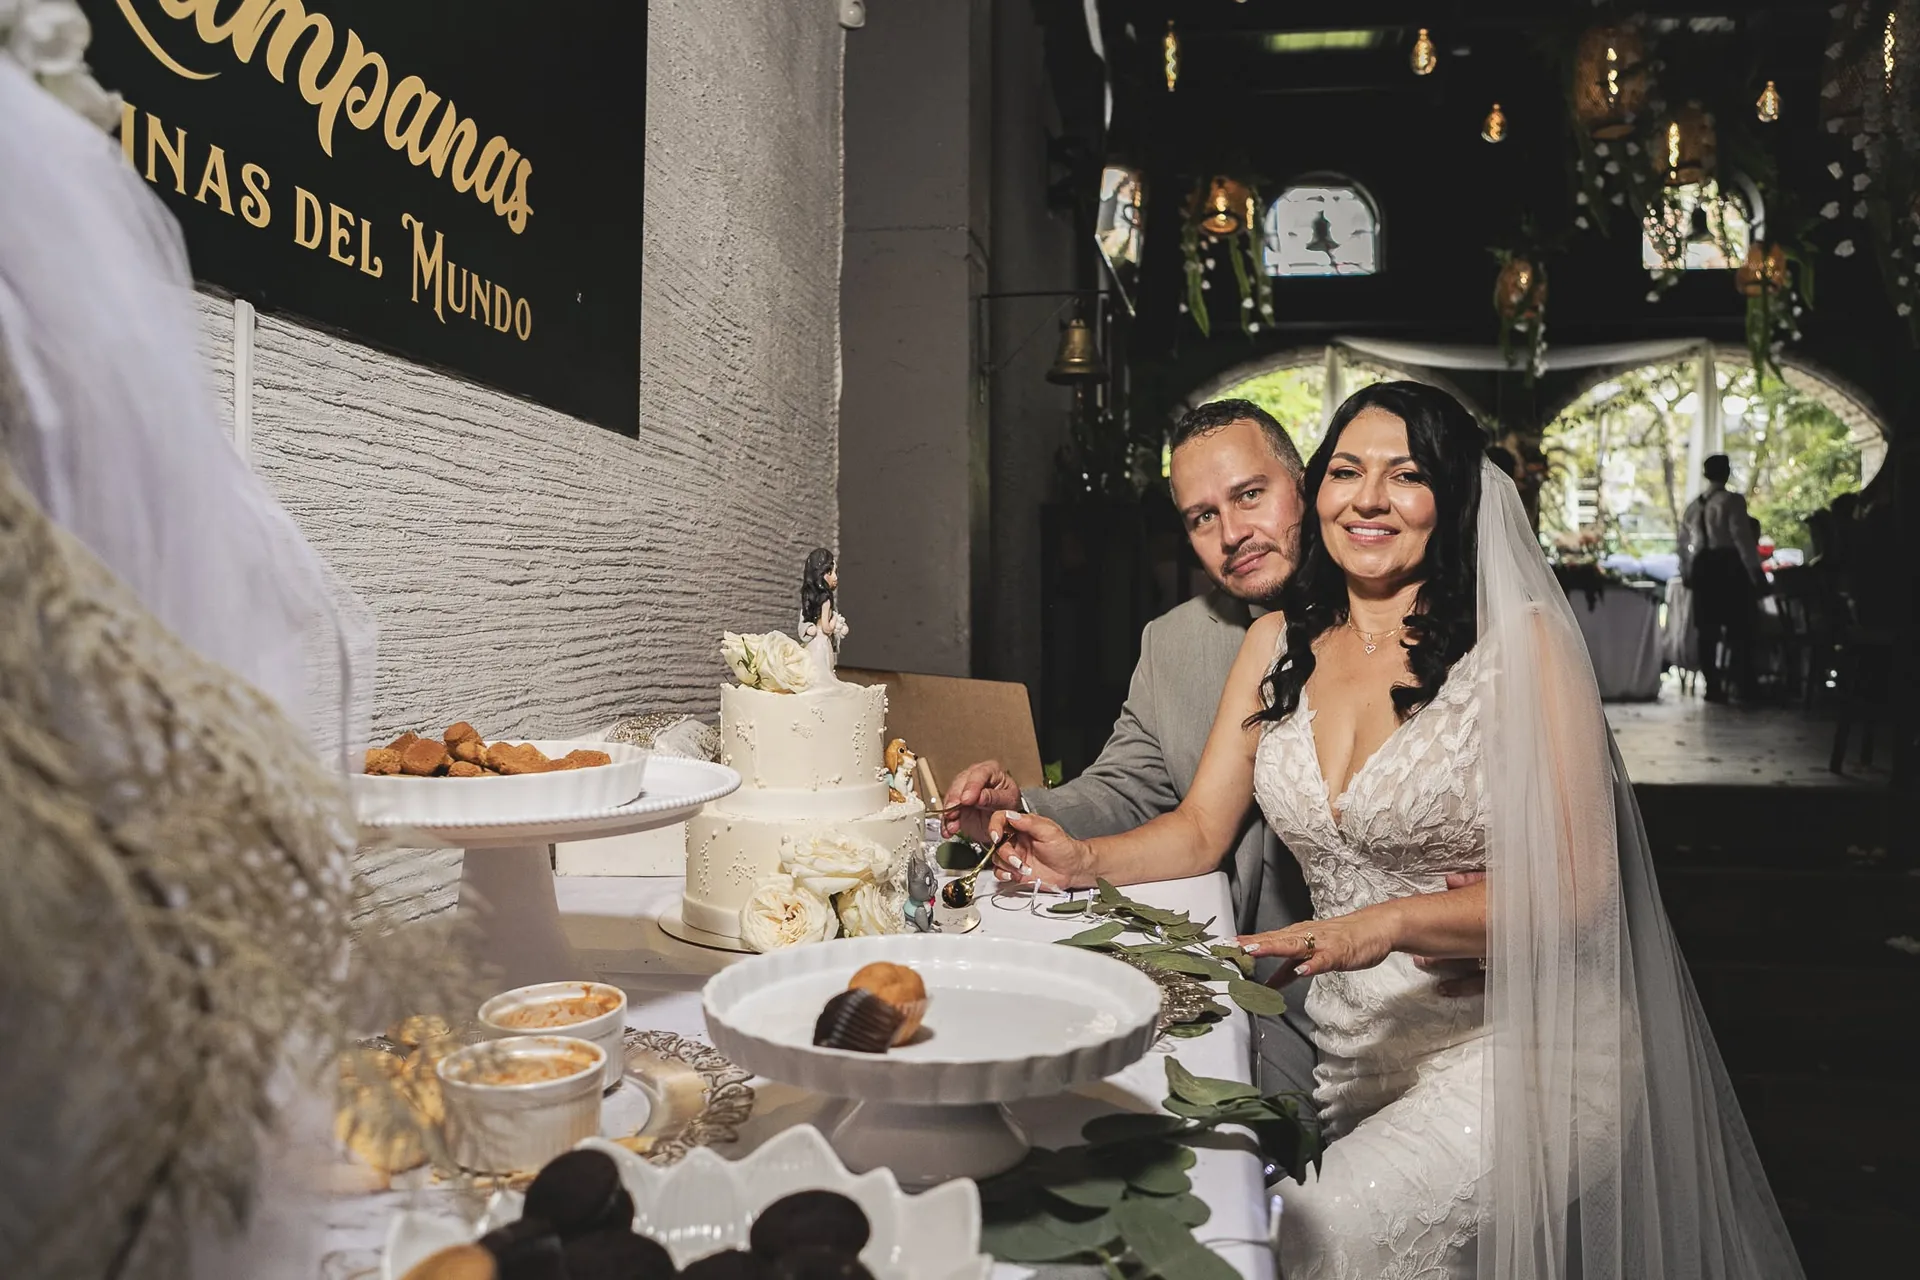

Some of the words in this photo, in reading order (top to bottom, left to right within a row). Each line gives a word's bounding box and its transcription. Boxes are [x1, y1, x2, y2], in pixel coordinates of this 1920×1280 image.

[119, 101, 271, 229] INAS
[294, 186, 383, 278] DEL
[401, 213, 532, 341] MUNDO
